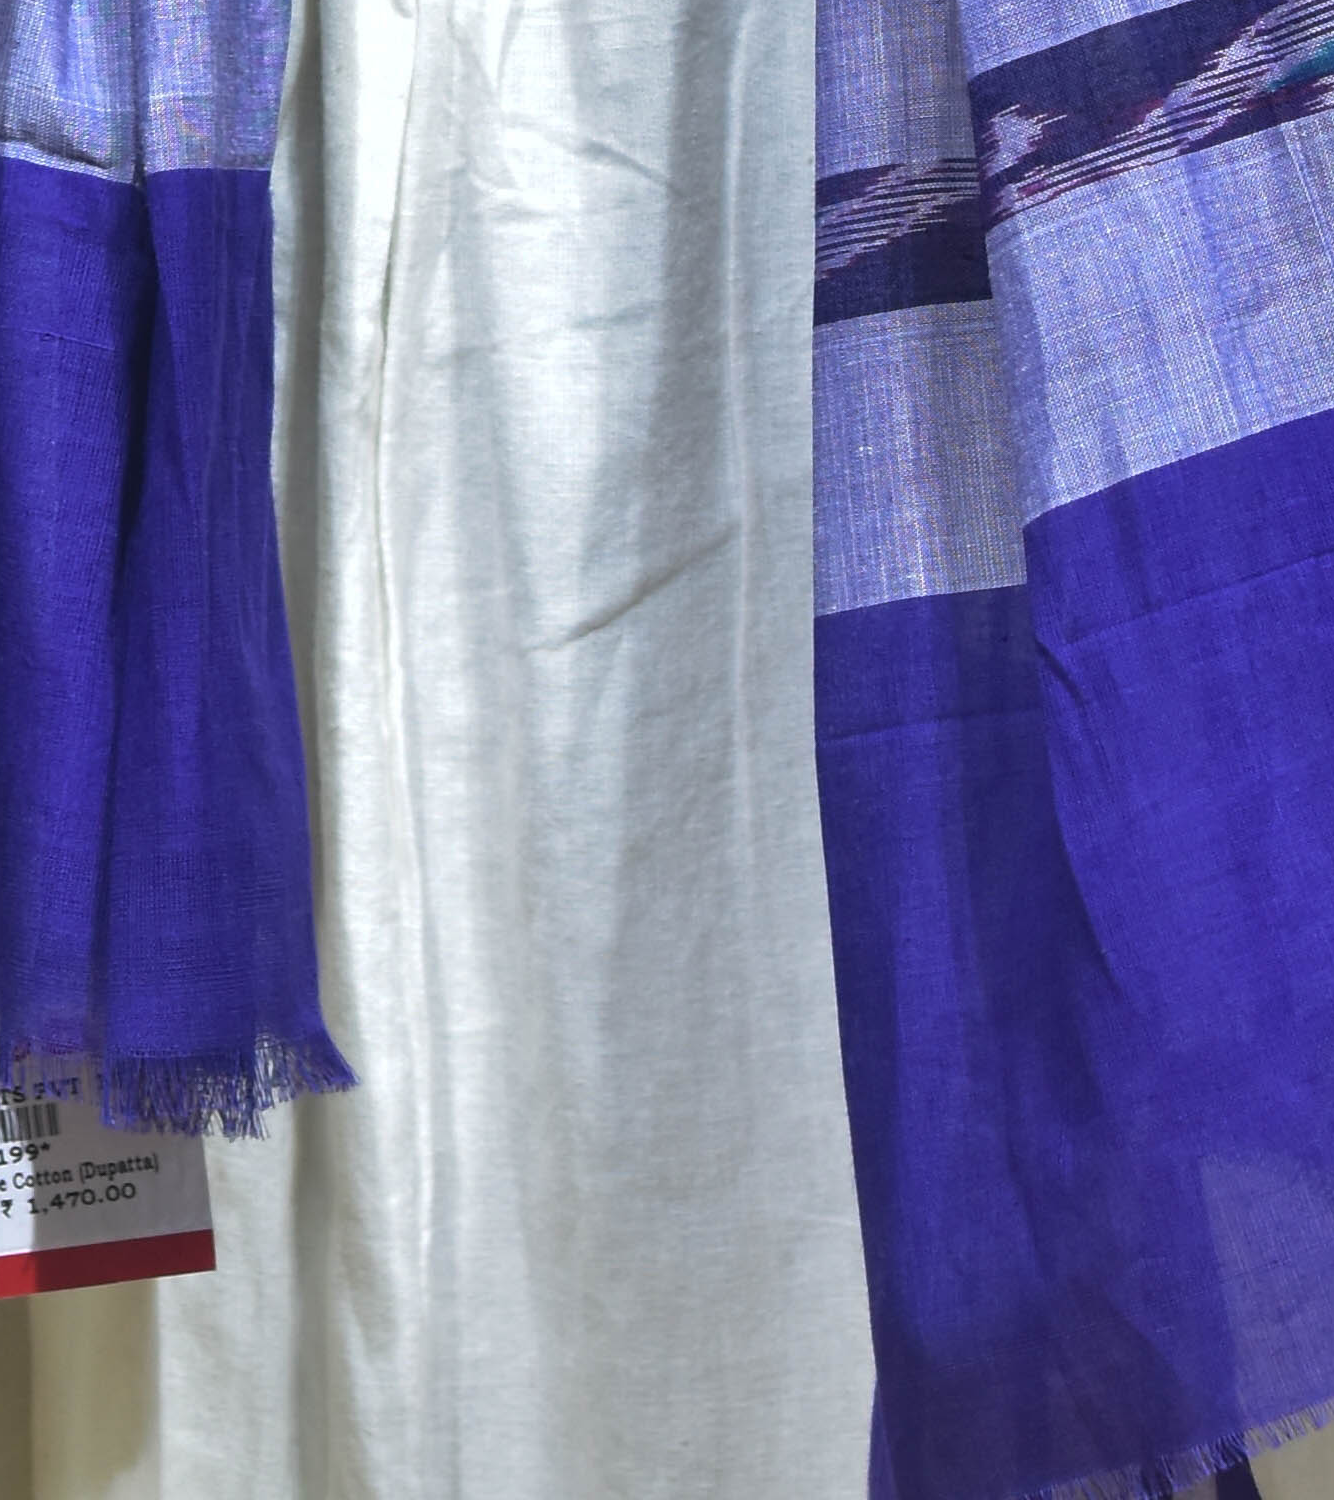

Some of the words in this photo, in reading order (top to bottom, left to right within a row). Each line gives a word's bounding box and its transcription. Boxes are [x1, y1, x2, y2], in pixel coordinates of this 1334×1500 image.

[12, 1167, 74, 1191] Cotton
[79, 1152, 160, 1184] (Dupatta)
[27, 1182, 137, 1216] 1,470.00
